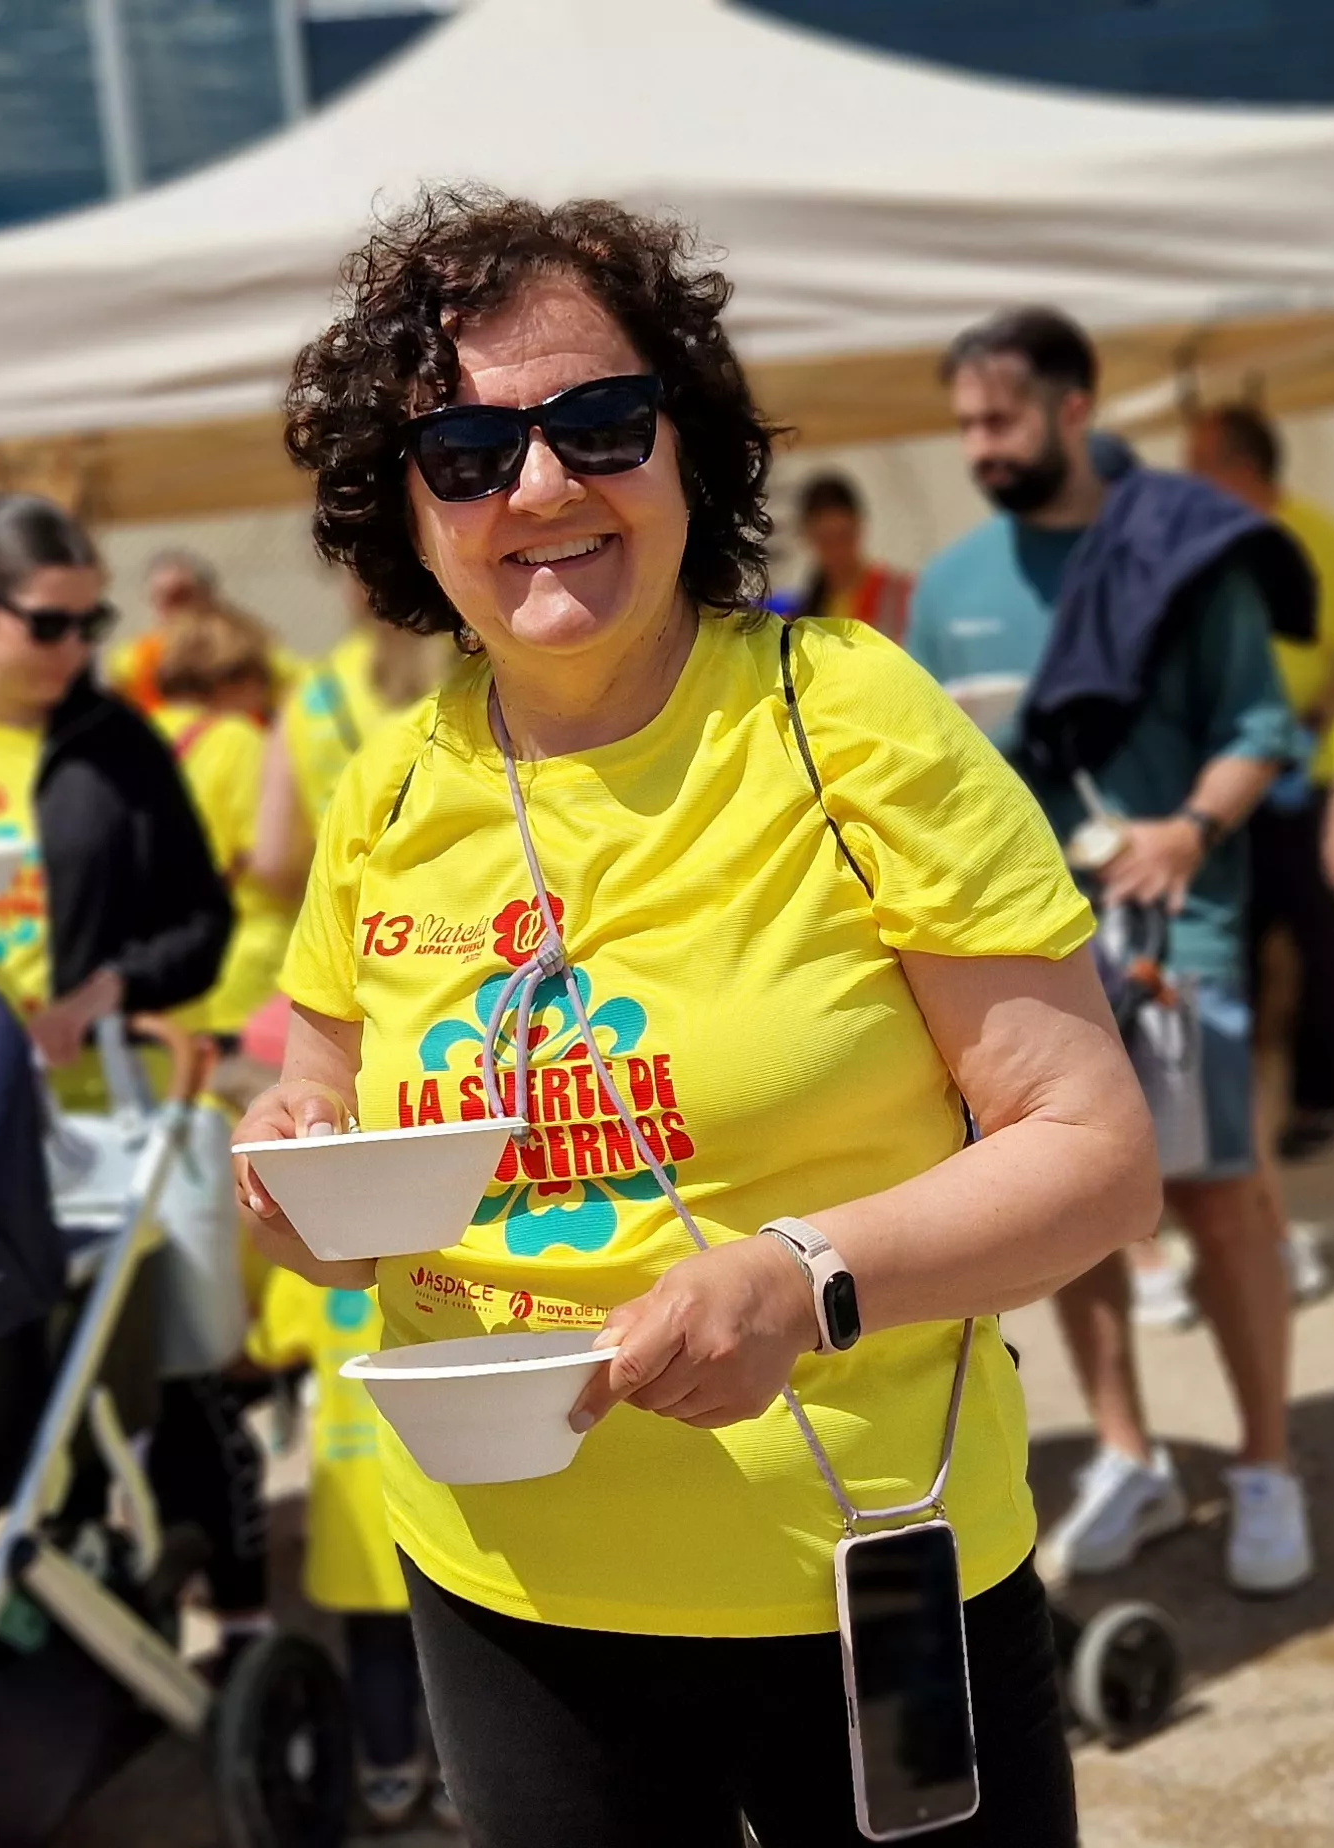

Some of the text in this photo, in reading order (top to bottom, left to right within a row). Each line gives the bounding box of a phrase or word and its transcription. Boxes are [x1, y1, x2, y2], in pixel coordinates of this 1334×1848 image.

[414, 943, 454, 956] ASPACE
[398, 1078, 445, 1128] LA
[627, 1053, 678, 1111] DE
[424, 1270, 496, 1302] ASPACE
[537, 1299, 573, 1319] hoya
[575, 1302, 593, 1317] de
